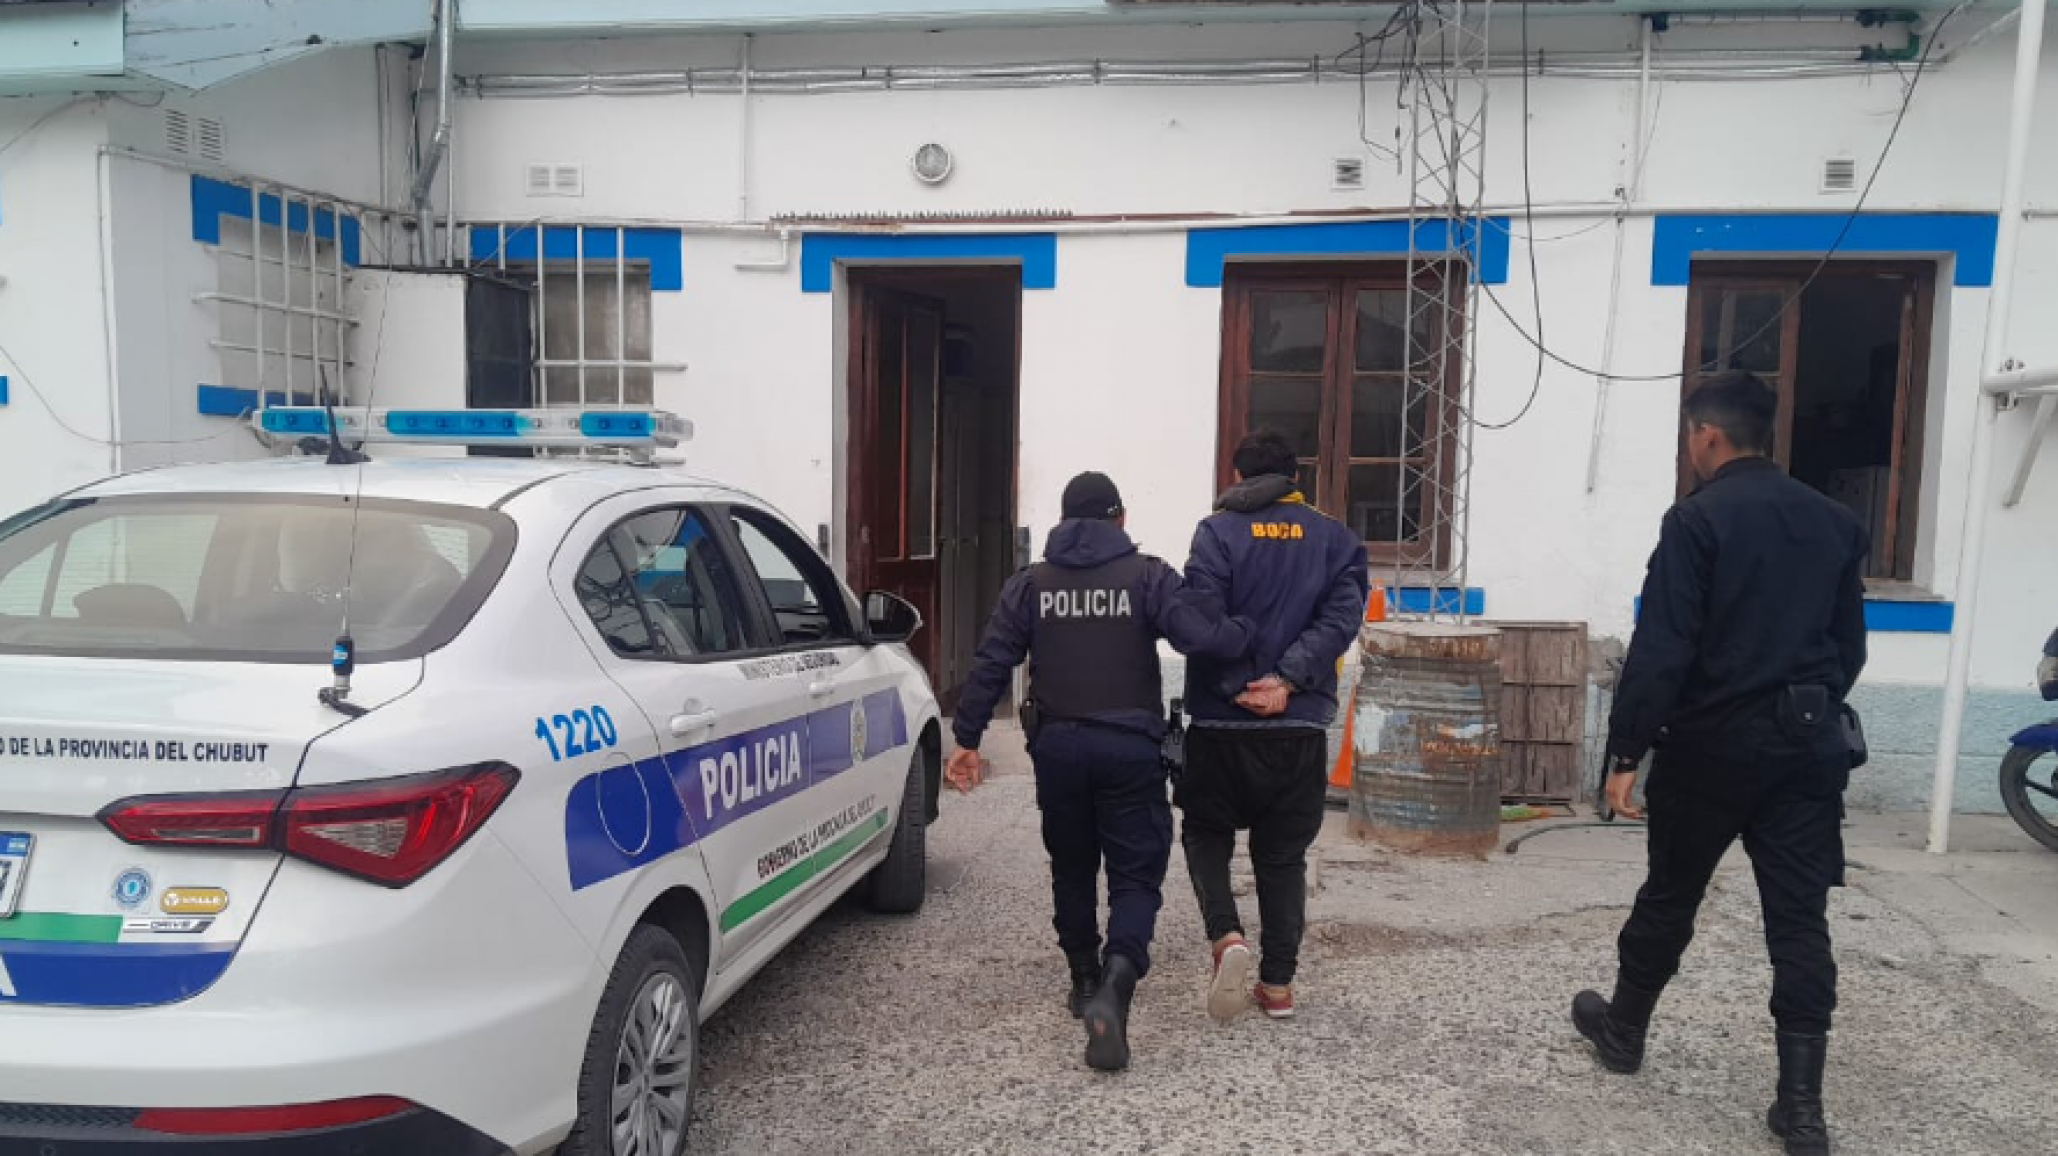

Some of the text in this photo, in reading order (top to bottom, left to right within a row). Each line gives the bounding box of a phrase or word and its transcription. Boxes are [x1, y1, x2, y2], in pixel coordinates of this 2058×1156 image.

[1251, 522, 1303, 539] BOCA
[1040, 589, 1131, 618] POLICIA
[535, 705, 618, 761] 1220
[9, 737, 30, 755] DE
[34, 738, 54, 757] LA
[59, 739, 150, 760] PROVINCIA
[155, 741, 188, 762] DEL
[194, 742, 269, 762] CHUBUT
[700, 731, 800, 819] POLICIA
